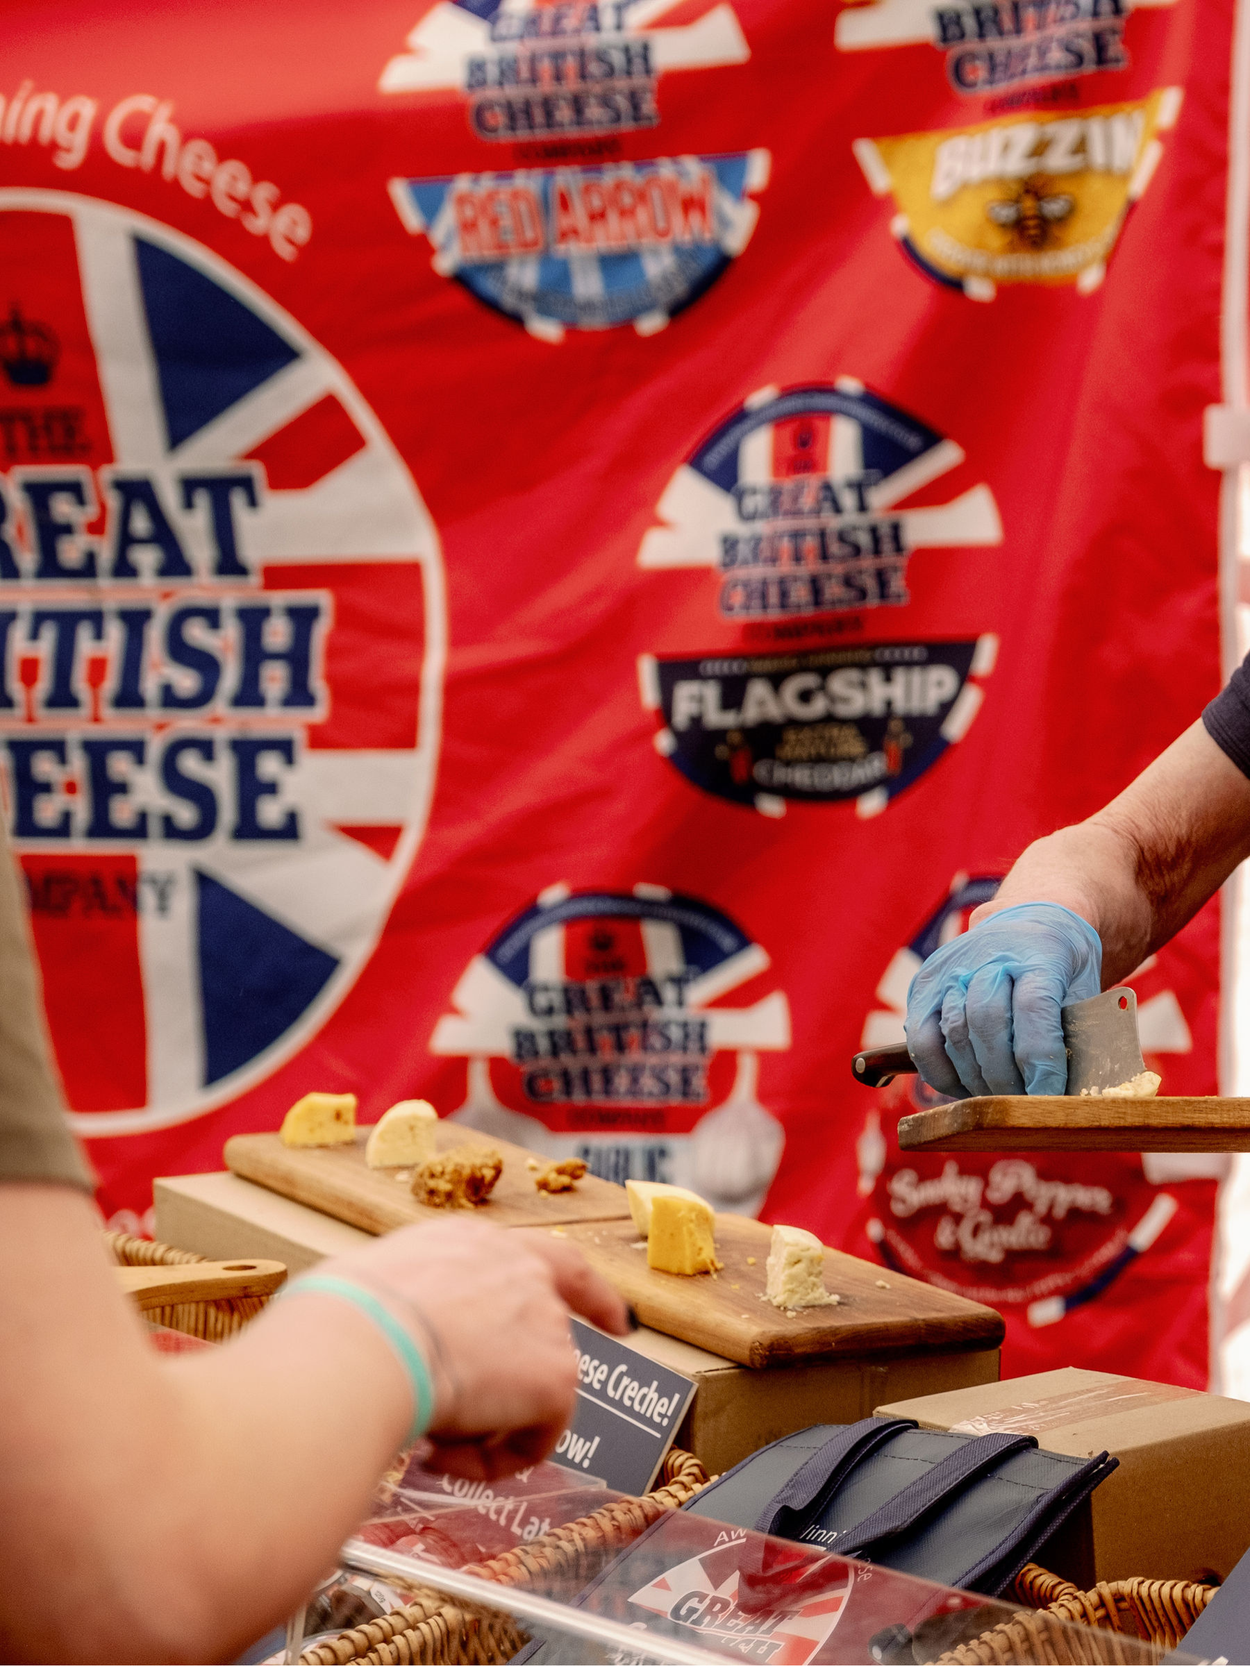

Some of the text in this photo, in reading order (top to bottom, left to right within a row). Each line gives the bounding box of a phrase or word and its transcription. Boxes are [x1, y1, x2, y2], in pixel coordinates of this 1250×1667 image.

[466, 40, 653, 93] BRITISH
[473, 89, 661, 136] CHEESE
[0, 78, 313, 263] ing Cheese
[456, 168, 718, 260] RED ARROW
[736, 476, 874, 521] GREAT
[0, 474, 260, 580] EAT
[719, 519, 907, 568] BRITISH
[671, 663, 961, 732] FLAGSHIP
[527, 973, 694, 1018] GREAT
[512, 1018, 709, 1060] BRITISH
[525, 1060, 708, 1103] CHEESE
[985, 1158, 1114, 1221] Pepper
[606, 1363, 681, 1427] Creche!
[799, 1524, 848, 1544] inn
[669, 1589, 801, 1638] GREAT
